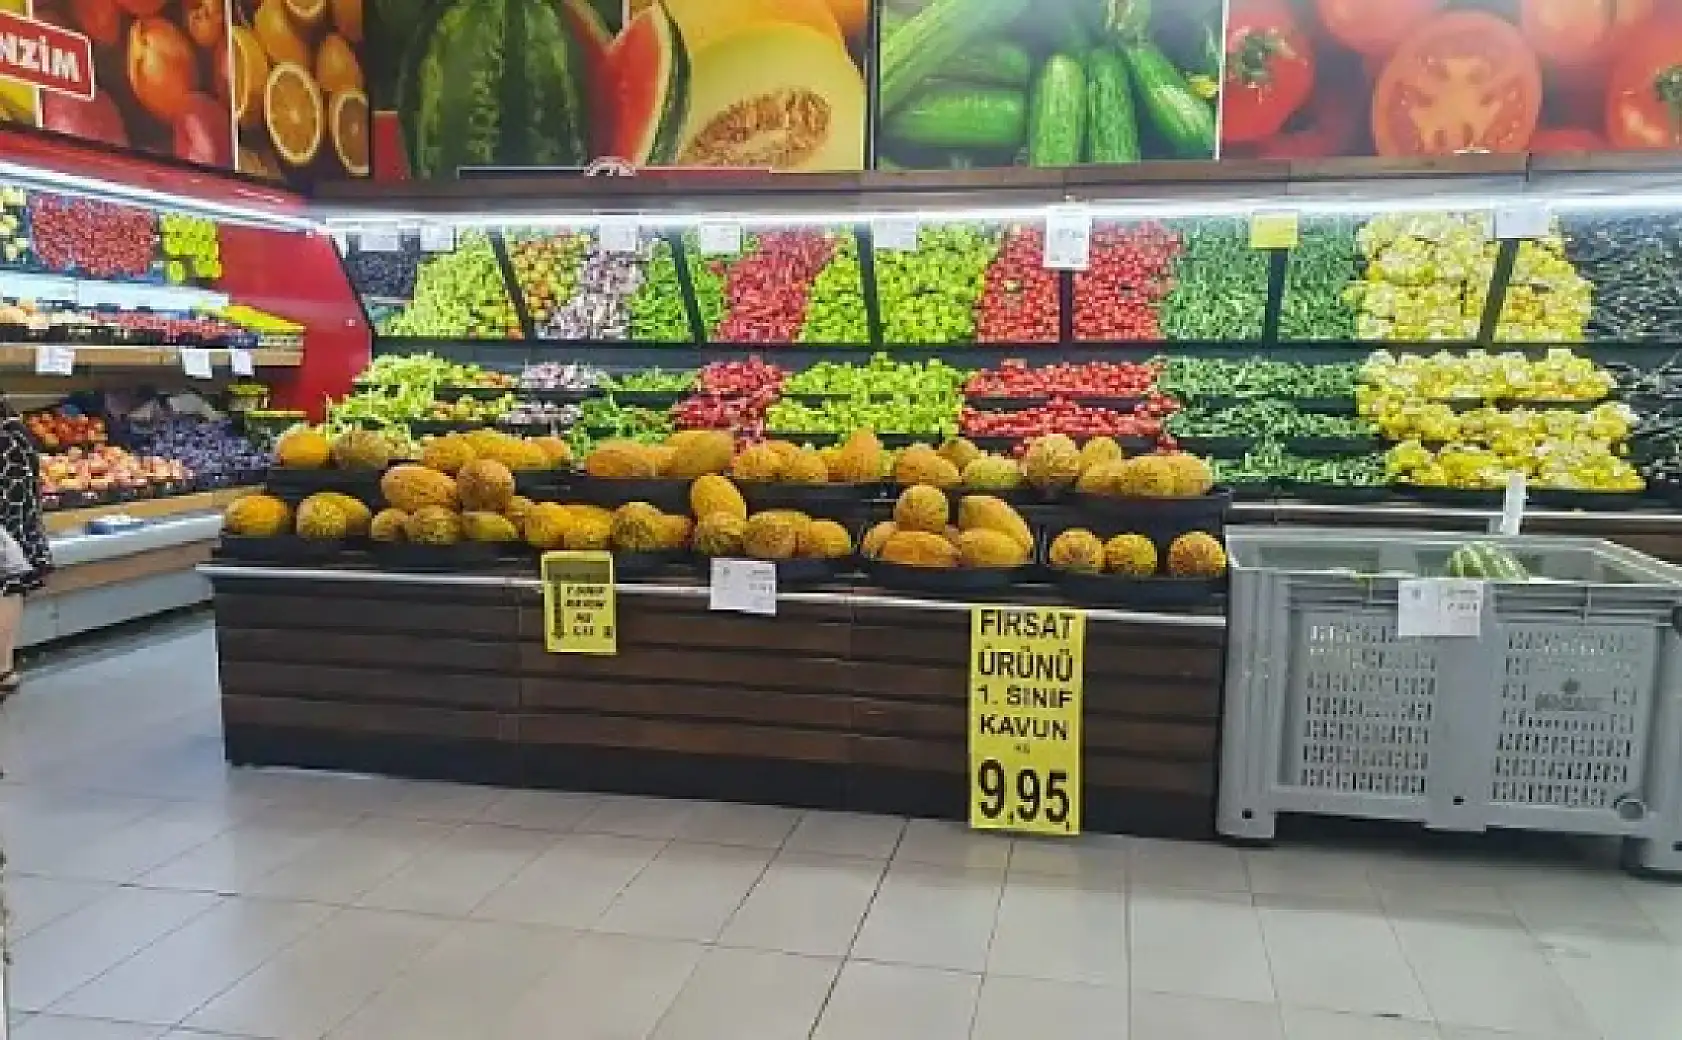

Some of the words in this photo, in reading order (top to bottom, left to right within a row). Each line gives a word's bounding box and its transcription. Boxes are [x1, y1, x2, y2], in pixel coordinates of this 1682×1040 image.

[980, 609, 1075, 639] FIRSAT
[978, 643, 1073, 682] ÜRÜNÜ
[1006, 685, 1073, 709] SINIF
[979, 713, 1067, 740] KAVUN
